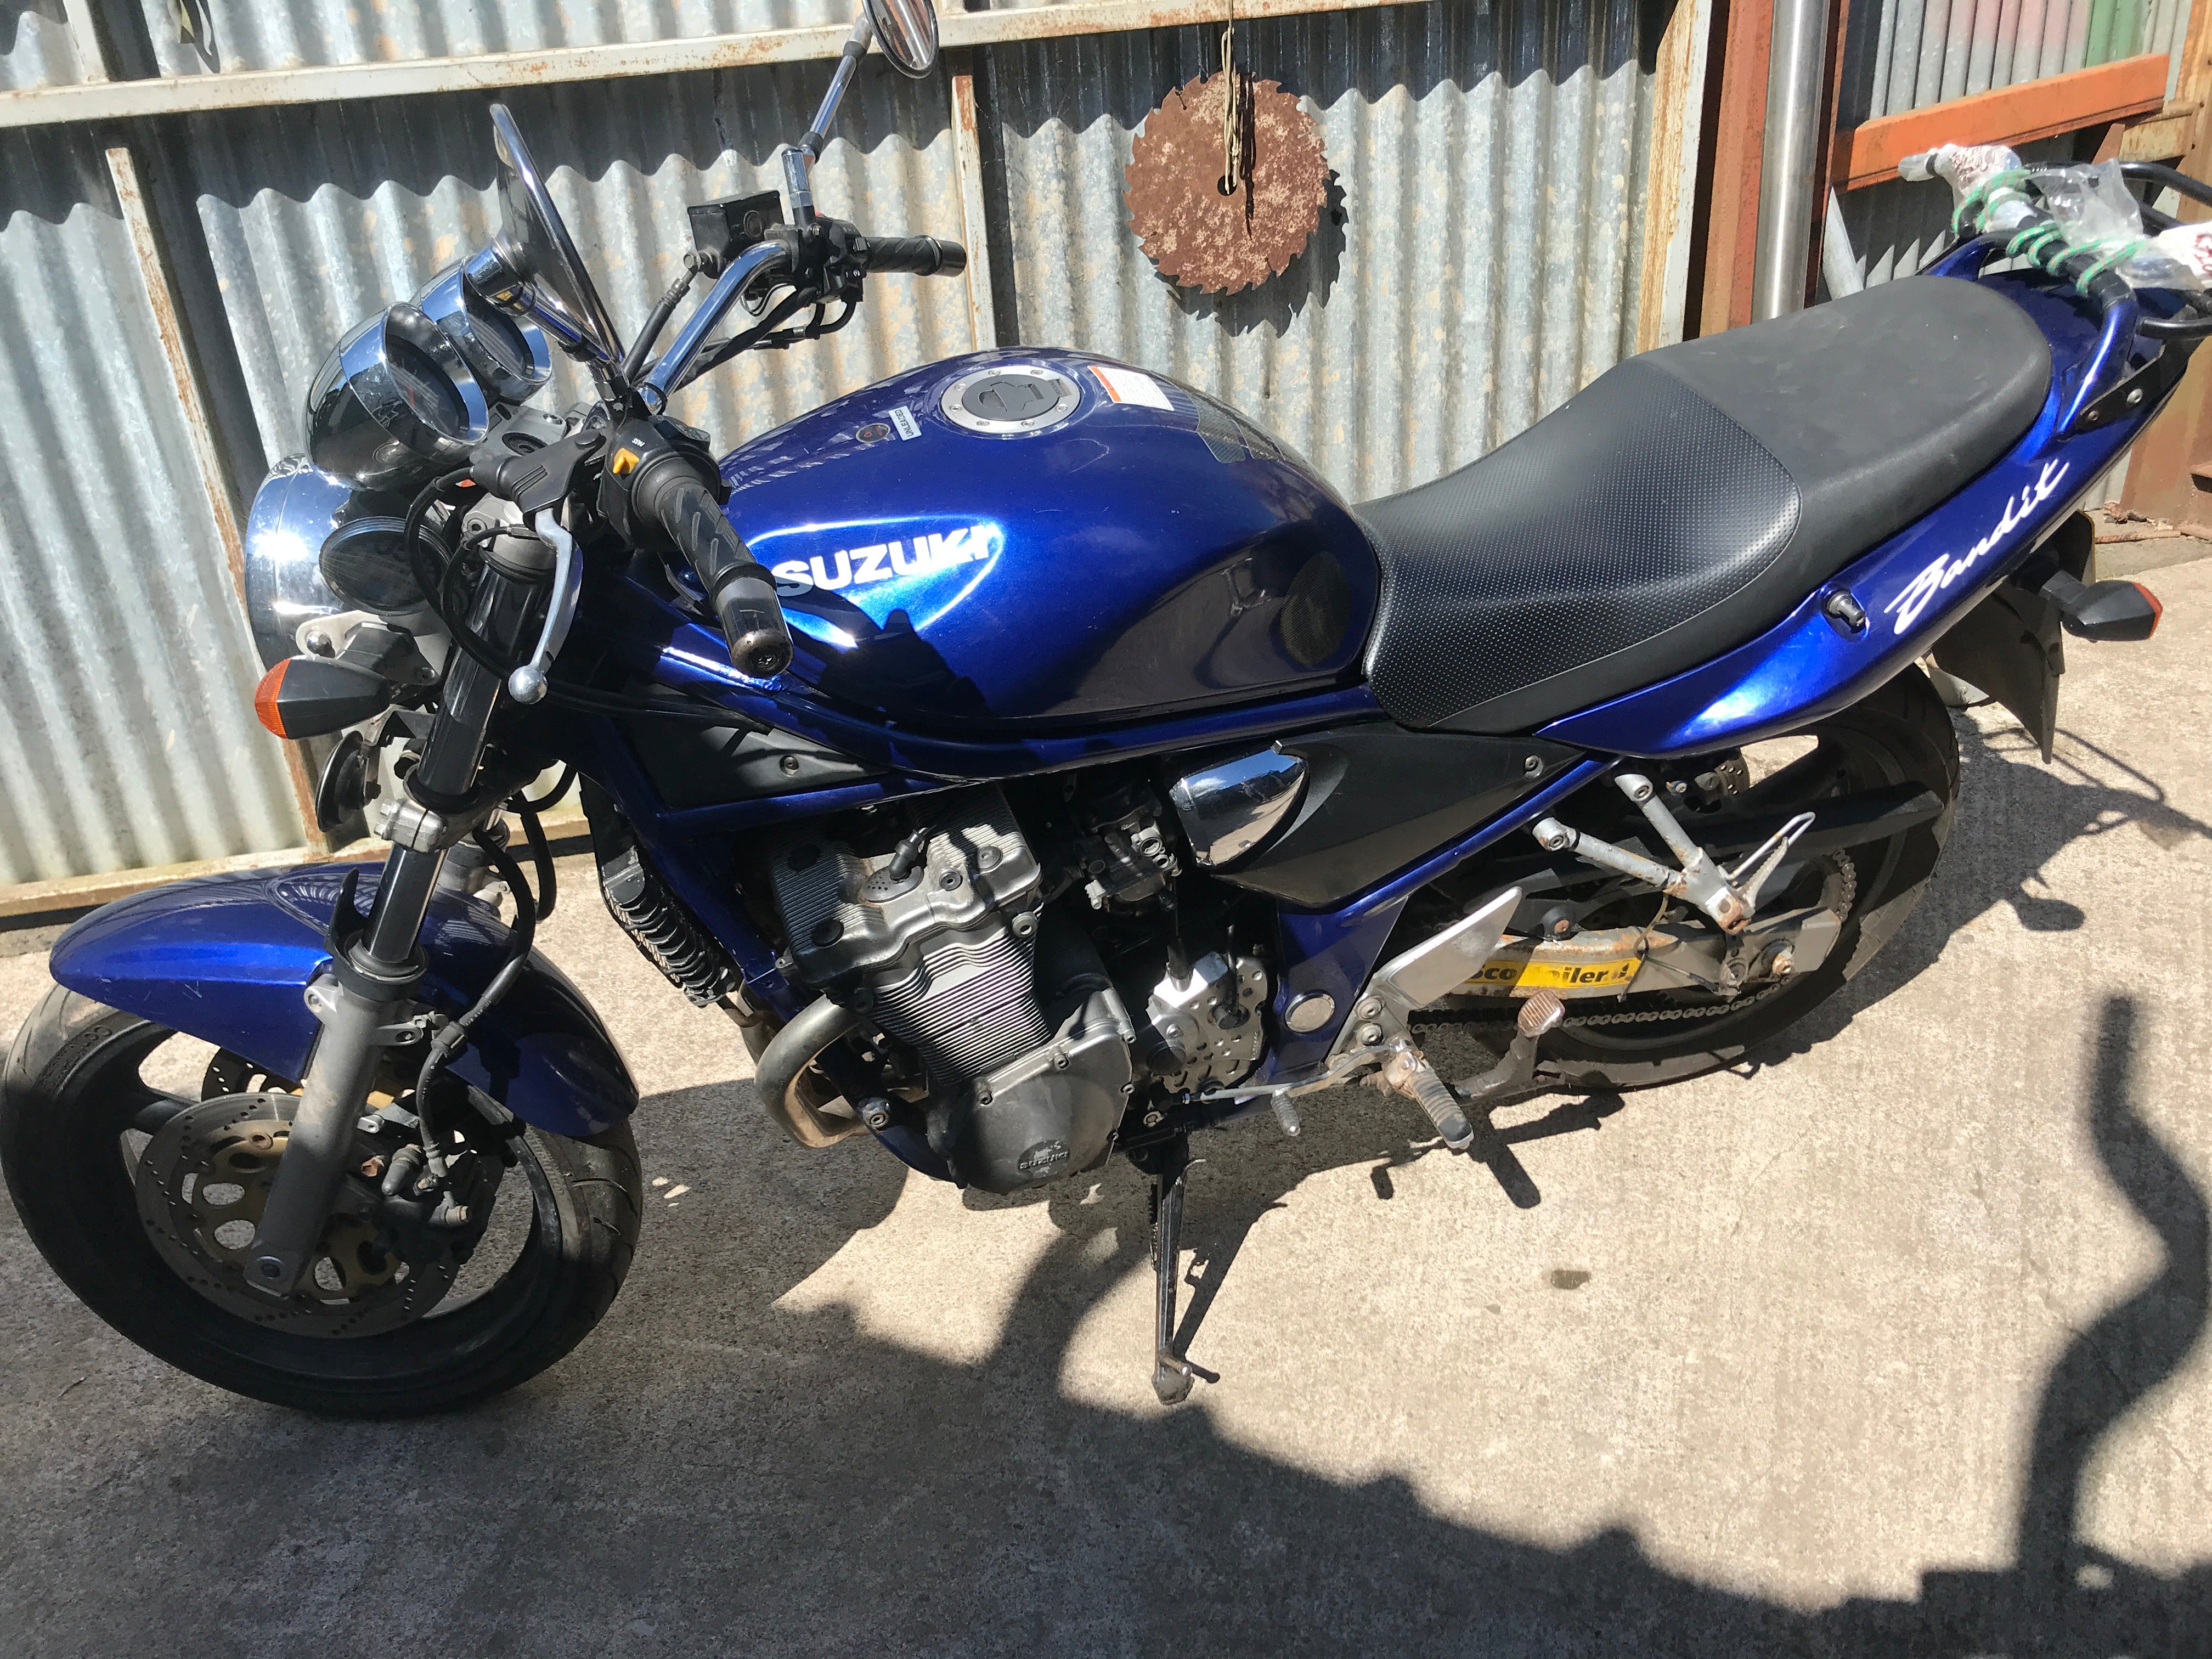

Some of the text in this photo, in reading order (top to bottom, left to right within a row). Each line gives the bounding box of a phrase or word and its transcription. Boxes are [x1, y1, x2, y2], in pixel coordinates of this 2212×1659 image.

[894, 409, 915, 437] UNLEADED
[771, 524, 989, 597] SUZUKI
[1883, 459, 2070, 635] Bandit
[1019, 1151, 1069, 1170] SUZUKI
